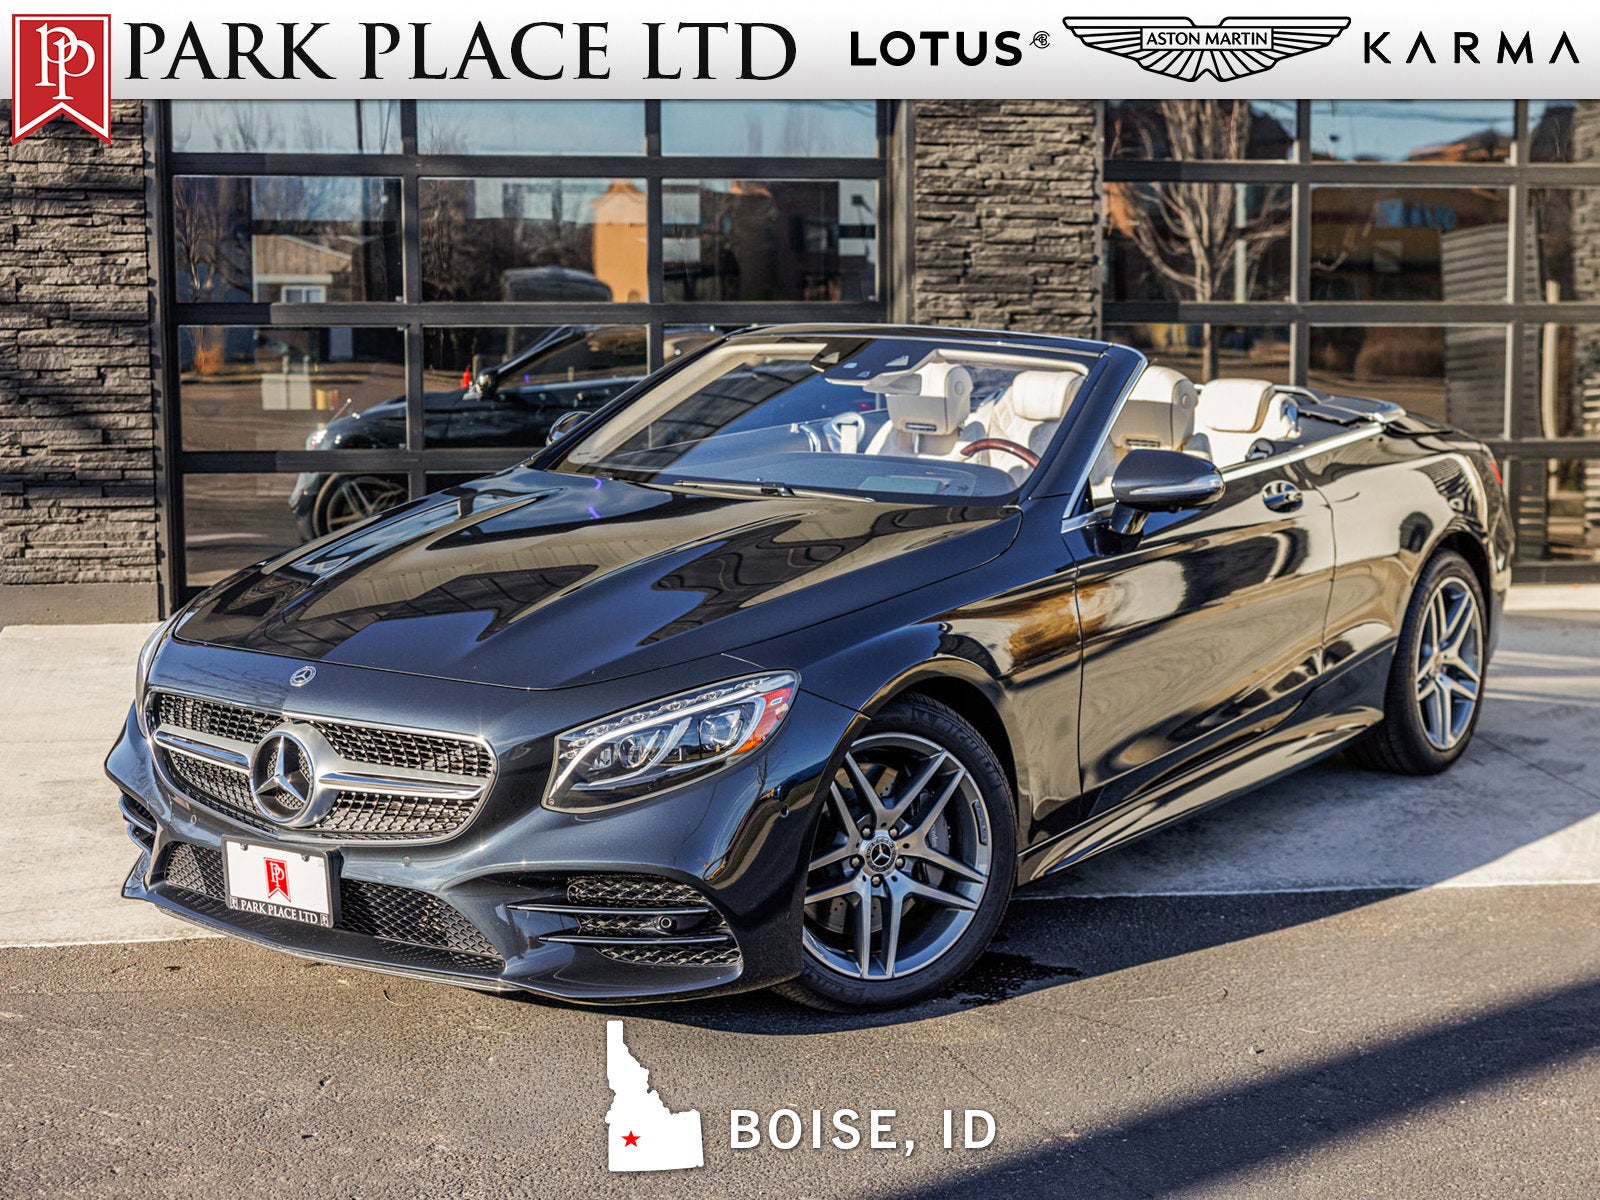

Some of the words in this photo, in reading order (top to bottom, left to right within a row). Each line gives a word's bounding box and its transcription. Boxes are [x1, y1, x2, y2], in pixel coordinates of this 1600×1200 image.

[241, 900, 267, 915] PARK
[267, 904, 297, 919] PLACE
[298, 910, 318, 924] LTD
